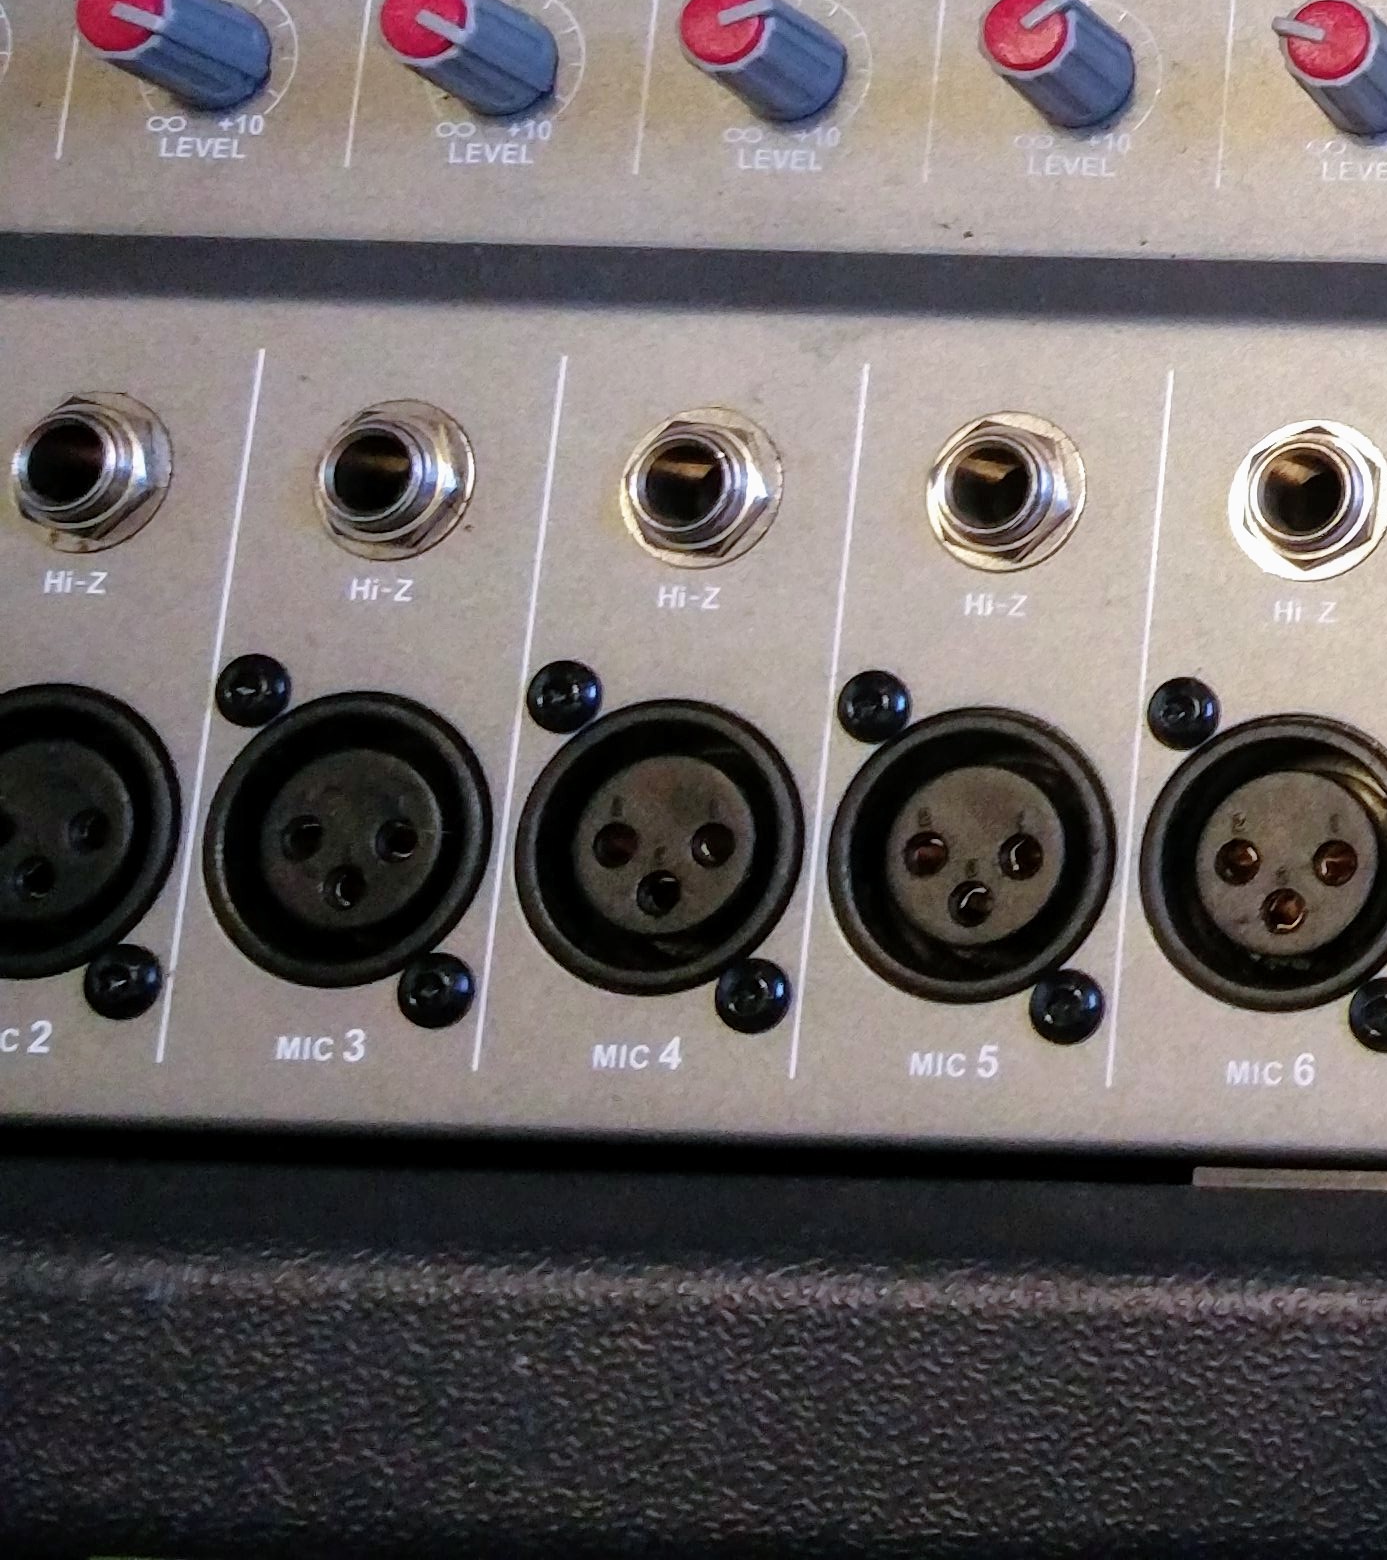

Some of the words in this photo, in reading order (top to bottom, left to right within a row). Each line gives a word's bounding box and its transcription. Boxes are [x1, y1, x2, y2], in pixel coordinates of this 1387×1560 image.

[218, 116, 264, 135] +10
[159, 138, 246, 158] LEVEL
[448, 144, 534, 164] LEVEL
[738, 150, 822, 170] LEVEL
[1028, 156, 1114, 176] LEVEL
[43, 571, 107, 594] Hi-Z
[350, 579, 413, 601] Hi-Z
[658, 587, 721, 609] Hi-Z
[964, 594, 1028, 617] Hi-Z
[25, 1020, 52, 1054] 2
[276, 1036, 333, 1063] MIC
[343, 1029, 367, 1062] 3
[592, 1043, 649, 1070] MIC
[658, 1037, 682, 1070] 4
[909, 1051, 966, 1078] MIC
[975, 1045, 999, 1078] 5
[1226, 1060, 1283, 1087] MIC
[1292, 1053, 1315, 1087] 6
